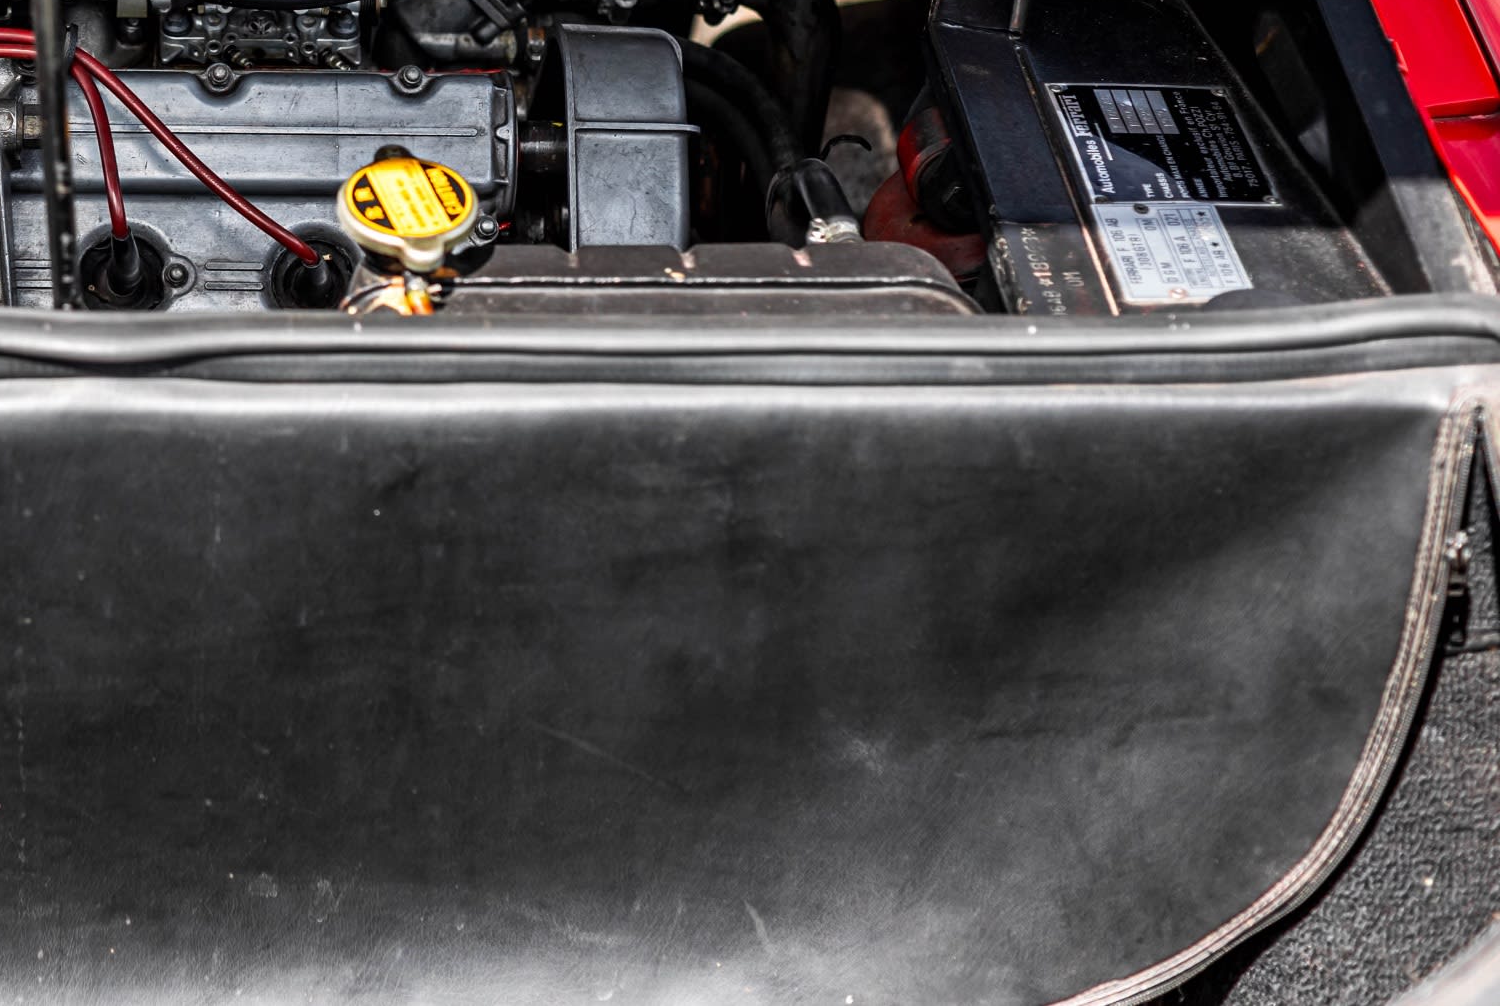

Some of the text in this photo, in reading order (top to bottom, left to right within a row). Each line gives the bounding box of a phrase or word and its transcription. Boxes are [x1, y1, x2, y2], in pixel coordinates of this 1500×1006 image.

[1171, 91, 1189, 113] France
[1058, 94, 1093, 137] Ferrari
[1183, 115, 1194, 124] en
[1203, 109, 1217, 121] Cyr
[1155, 134, 1172, 154] CHARGE
[1187, 127, 1209, 153] exclusif
[1214, 133, 1234, 160] Gouvion
[1229, 140, 1246, 160] PARIS
[1081, 139, 1117, 193] Automobiles
[1164, 156, 1175, 164] EN
[1206, 140, 1233, 181] Automobiles
[1168, 165, 1182, 179] MAXI
[1202, 157, 1229, 197] Importateur
[1141, 183, 1156, 197] TYPE
[1155, 172, 1174, 198] CHASSIS
[1175, 180, 1190, 197] POIDS
[1104, 218, 1120, 226] AB
[1110, 230, 1125, 241] 106
[1120, 255, 1142, 284] FERRARI
